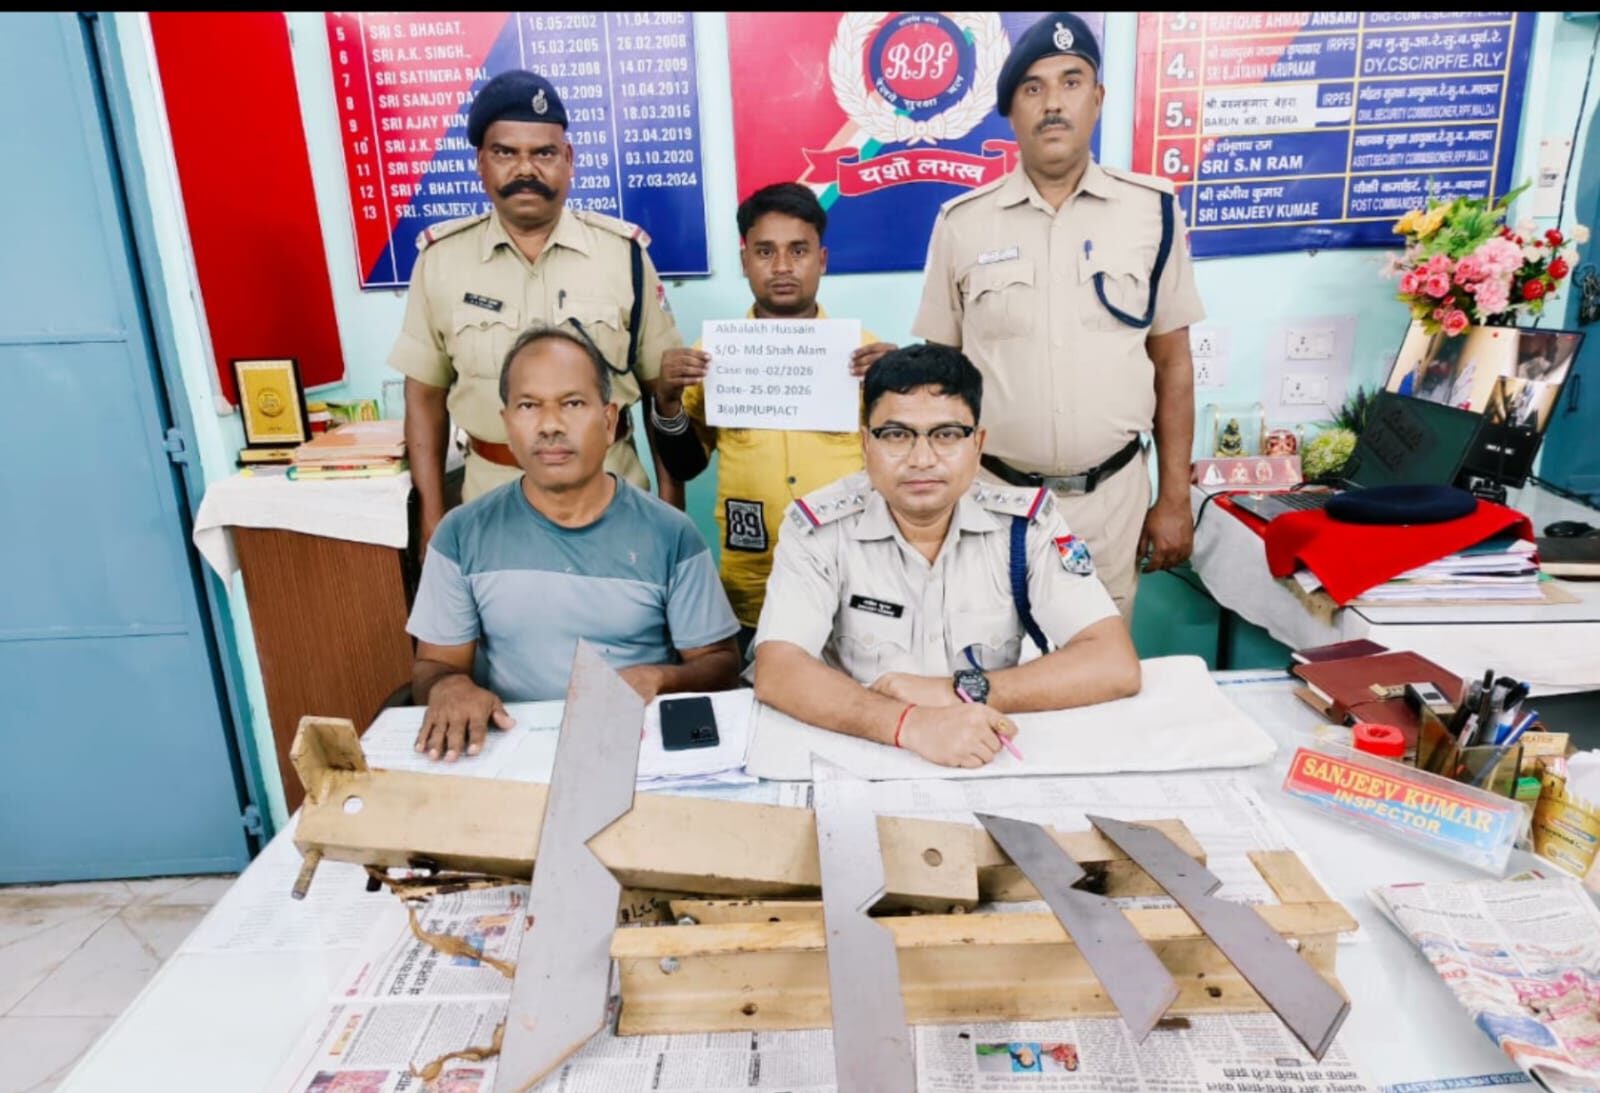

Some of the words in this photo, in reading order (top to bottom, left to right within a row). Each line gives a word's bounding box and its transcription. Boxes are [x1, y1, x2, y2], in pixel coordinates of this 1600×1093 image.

[336, 27, 345, 41] 5
[369, 25, 391, 40] SRI
[410, 21, 466, 37] BHAGAT.
[1326, 37, 1356, 51] IRPFS
[340, 50, 348, 65] 6
[372, 48, 394, 62] SRI
[397, 47, 422, 61] A.K.
[619, 58, 688, 74] 14.07.2009
[1166, 53, 1194, 79] 4.
[1364, 52, 1504, 73] DY.CSC/RPF/E.RLY
[342, 74, 350, 88] 7
[376, 72, 397, 86] SRI
[621, 81, 689, 97] 10.04.2013
[346, 97, 354, 110] 8
[379, 94, 400, 108] SRI
[402, 92, 453, 106] SANJOY
[1322, 92, 1351, 106] IRPFS
[623, 105, 691, 120] 18.03.2016
[1165, 102, 1192, 127] 5.
[348, 119, 357, 132] 9
[382, 117, 403, 131] SRI
[406, 115, 439, 130] AJAY
[1205, 118, 1238, 127] BARUN
[1265, 115, 1298, 125] BEHRA
[623, 128, 692, 143] 23.04.2019
[385, 139, 406, 153] SRI
[409, 138, 432, 151] J.K.
[626, 150, 693, 166] 03.10.2020
[1163, 148, 1190, 174] 6.
[1202, 159, 1228, 174] SRI
[1234, 157, 1261, 173] S.N
[1267, 155, 1303, 170] RAM
[356, 164, 370, 176] 11
[387, 162, 408, 175] SRI
[411, 159, 465, 174] SOUMEN
[628, 172, 697, 188] 27.03.2024
[360, 185, 374, 199] 12
[390, 184, 412, 197] SRI
[415, 183, 427, 196] P.
[362, 206, 377, 220] 13
[422, 202, 476, 217] SANJEEV
[1199, 207, 1218, 222] SRI
[1221, 205, 1274, 221] SANJEEV
[715, 323, 768, 334] Akhalakh
[771, 324, 815, 334] Hussain
[744, 345, 763, 355] Md
[766, 345, 794, 355] Shah
[797, 345, 827, 356] Alam
[716, 365, 742, 375] Case
[745, 367, 759, 375] no
[732, 510, 761, 537] 89
[1302, 757, 1400, 800] SANJEEV
[1403, 788, 1495, 834] KUMAR
[1335, 789, 1442, 833] INSPECTOR
